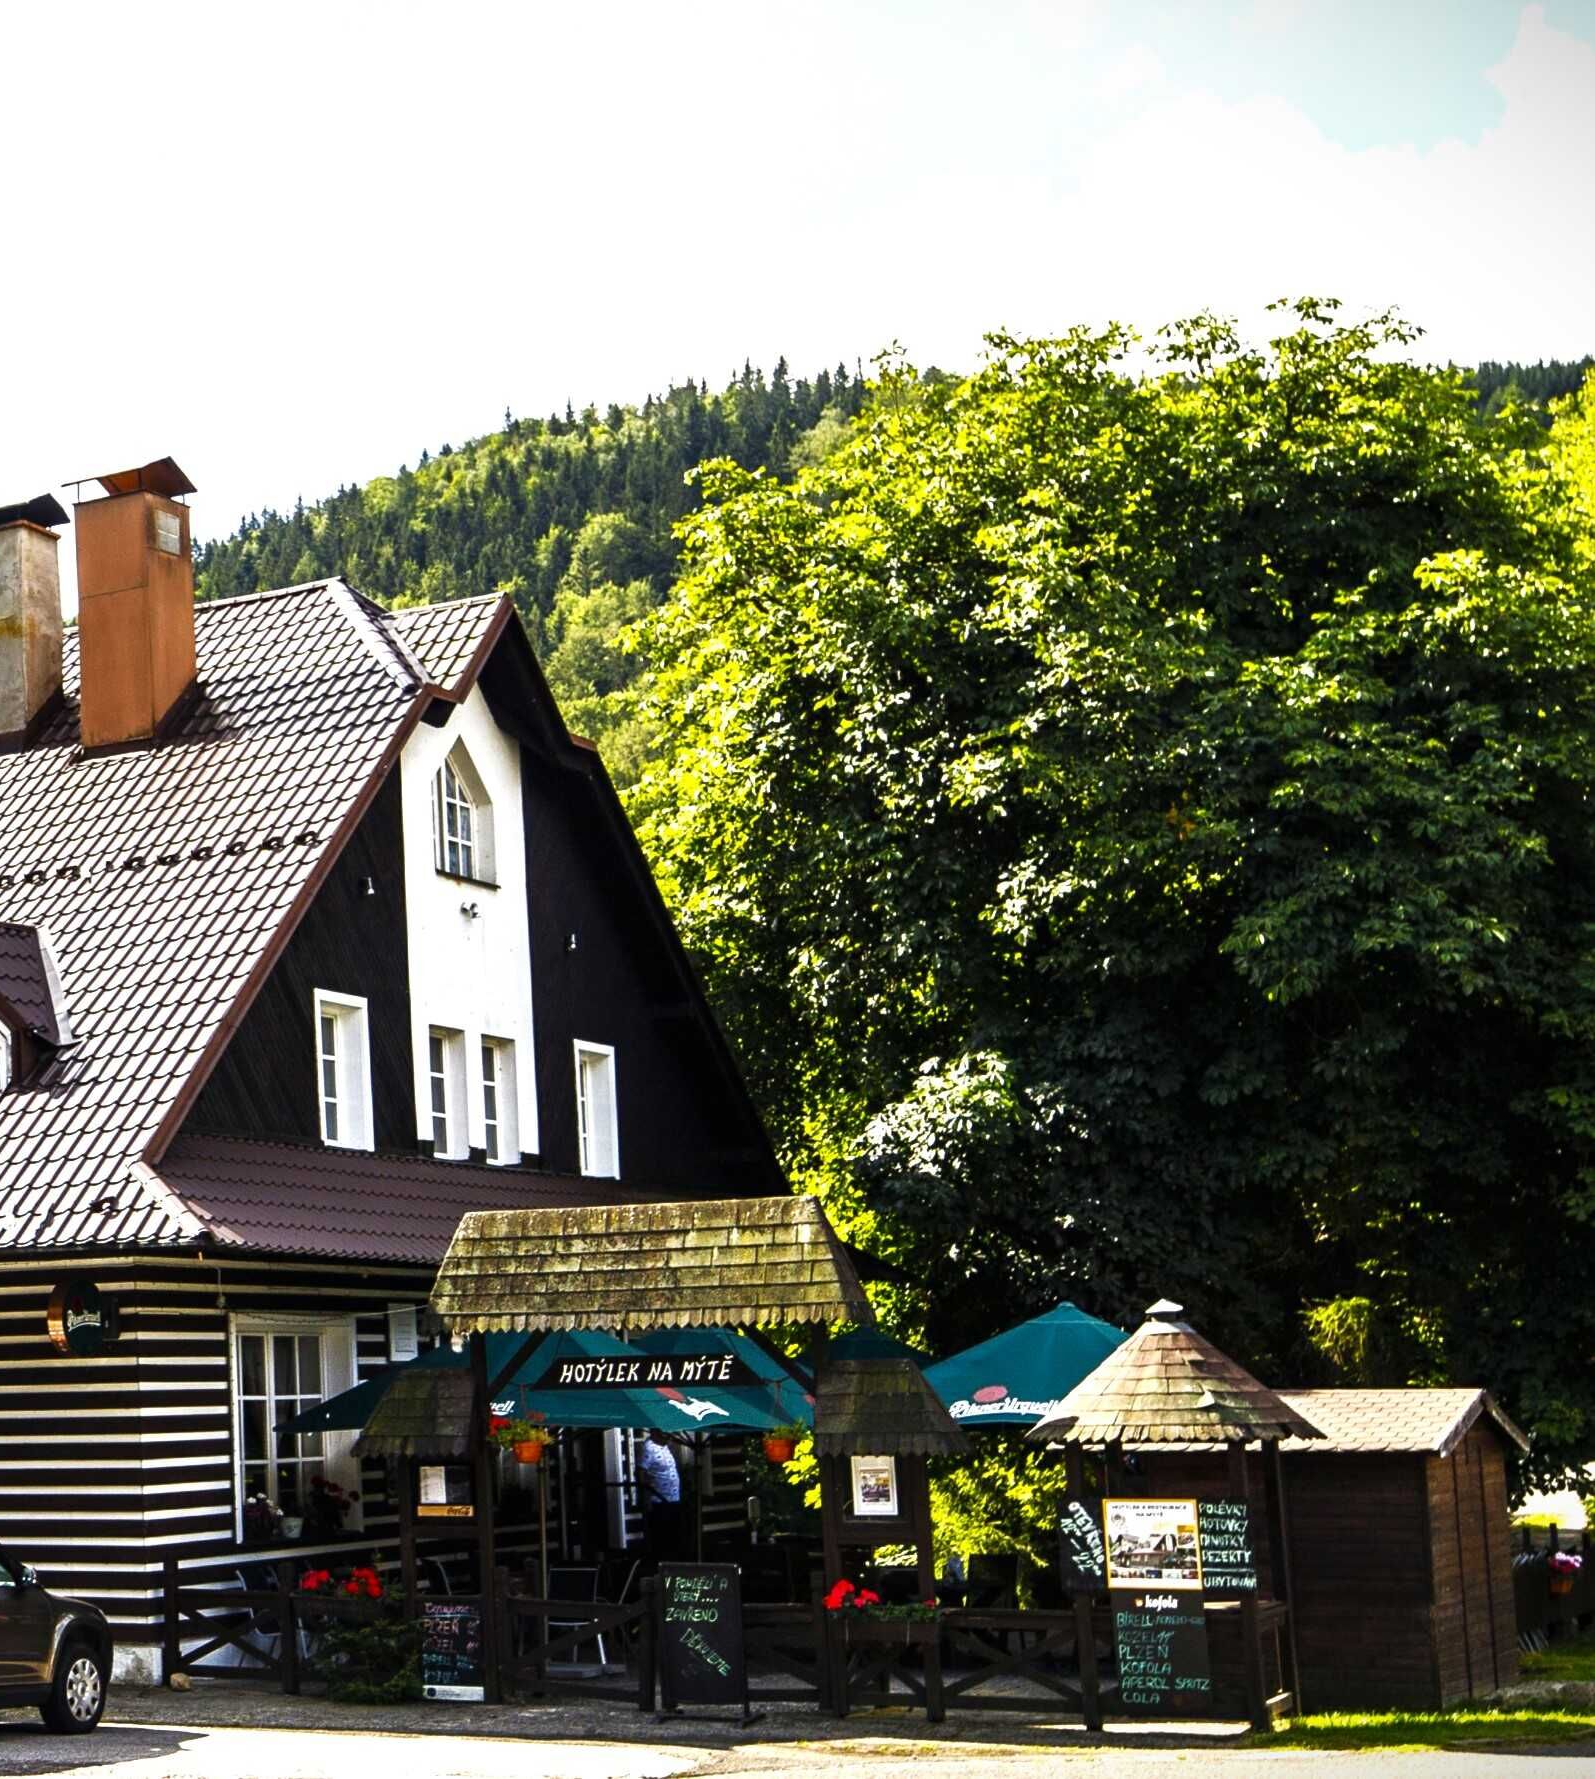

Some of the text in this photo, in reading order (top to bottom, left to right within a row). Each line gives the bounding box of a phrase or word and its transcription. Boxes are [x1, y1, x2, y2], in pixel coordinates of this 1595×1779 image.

[559, 1355, 734, 1383] HOTÝLEK NA MÝTĚ
[948, 1399, 1008, 1419] Pilsner
[1198, 1499, 1247, 1517] POLÉVKY
[1199, 1516, 1249, 1533] HOTOVKY
[1201, 1550, 1252, 1564] DEZERTY
[1144, 1594, 1179, 1612] kofola
[1120, 1661, 1172, 1675] KOFOLA
[1121, 1676, 1171, 1690] APEROL
[1122, 1692, 1161, 1705] COLA
